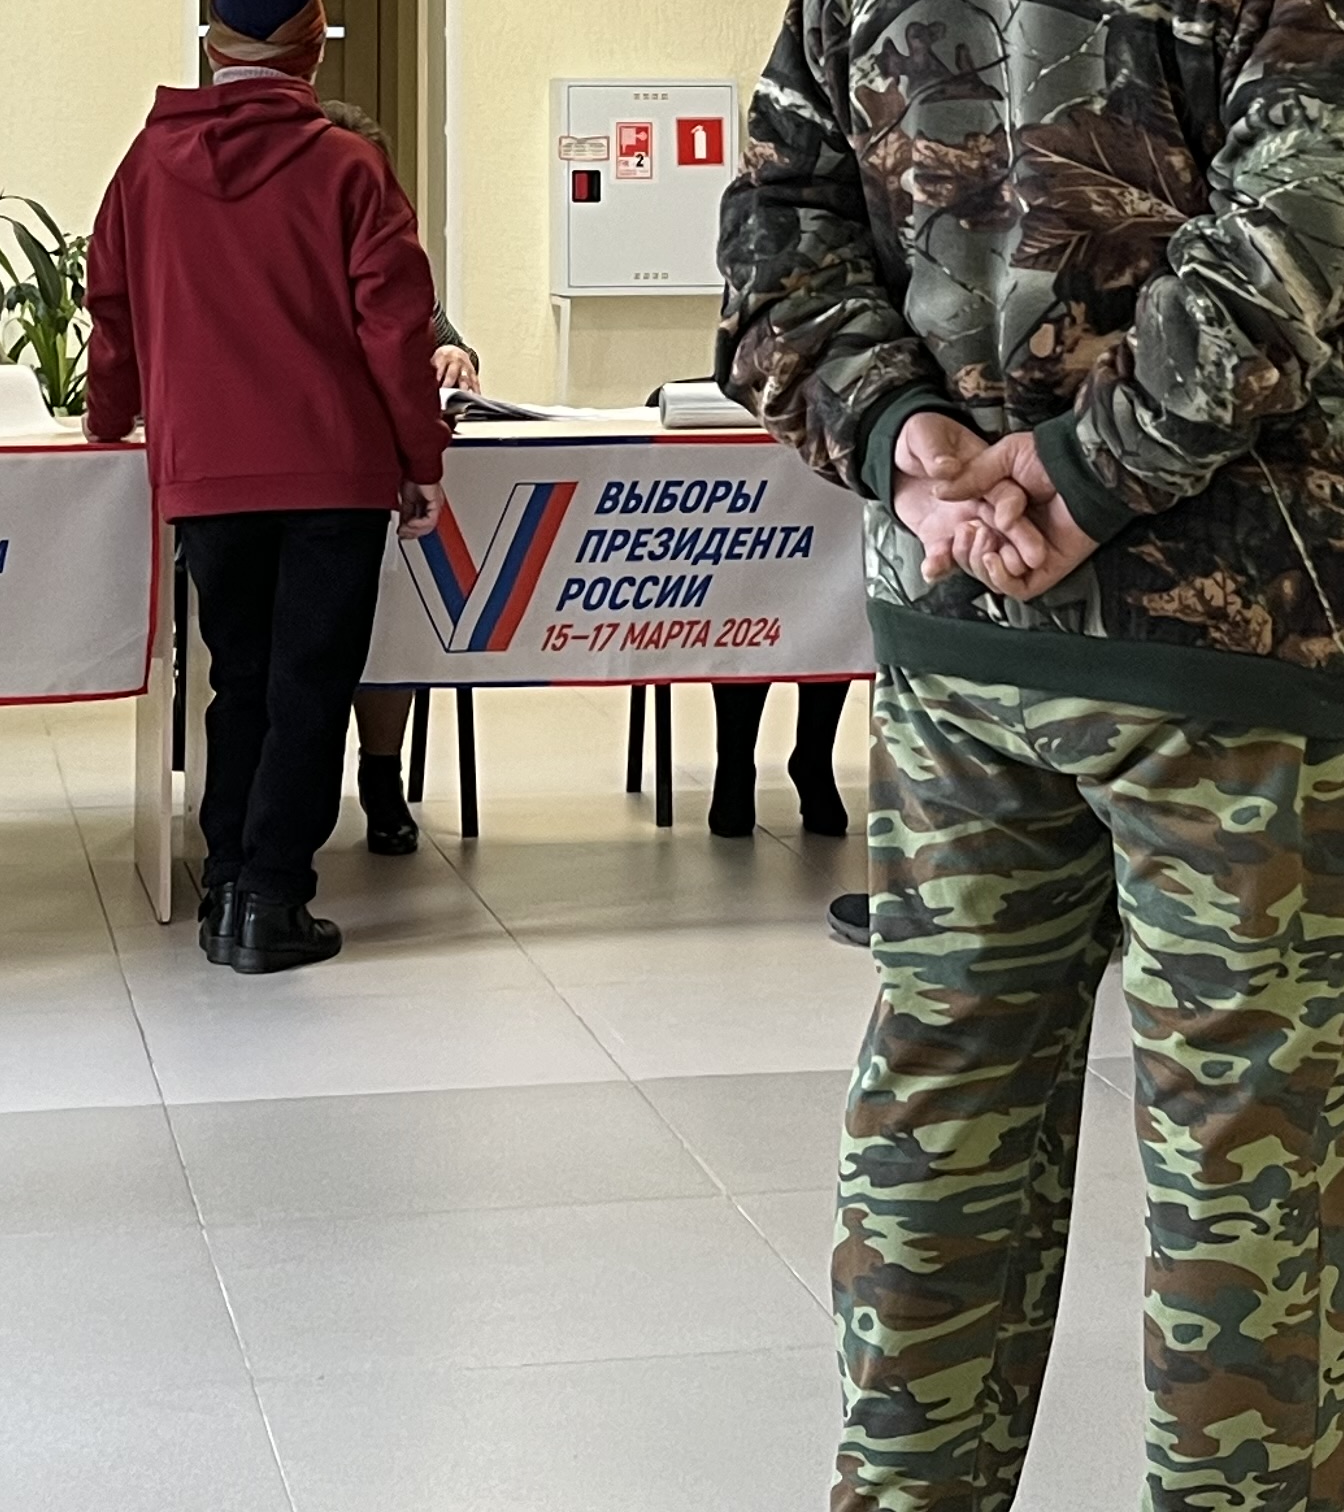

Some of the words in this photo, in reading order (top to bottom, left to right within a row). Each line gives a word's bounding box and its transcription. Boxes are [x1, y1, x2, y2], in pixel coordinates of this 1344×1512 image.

[635, 153, 644, 168] 2
[594, 479, 768, 515] ВЫБОРЫ
[575, 525, 815, 566] ПРЕЗИДЕНТА
[556, 574, 713, 612] РОССИИ
[620, 619, 711, 651] МАРТА
[714, 617, 781, 648] 2024
